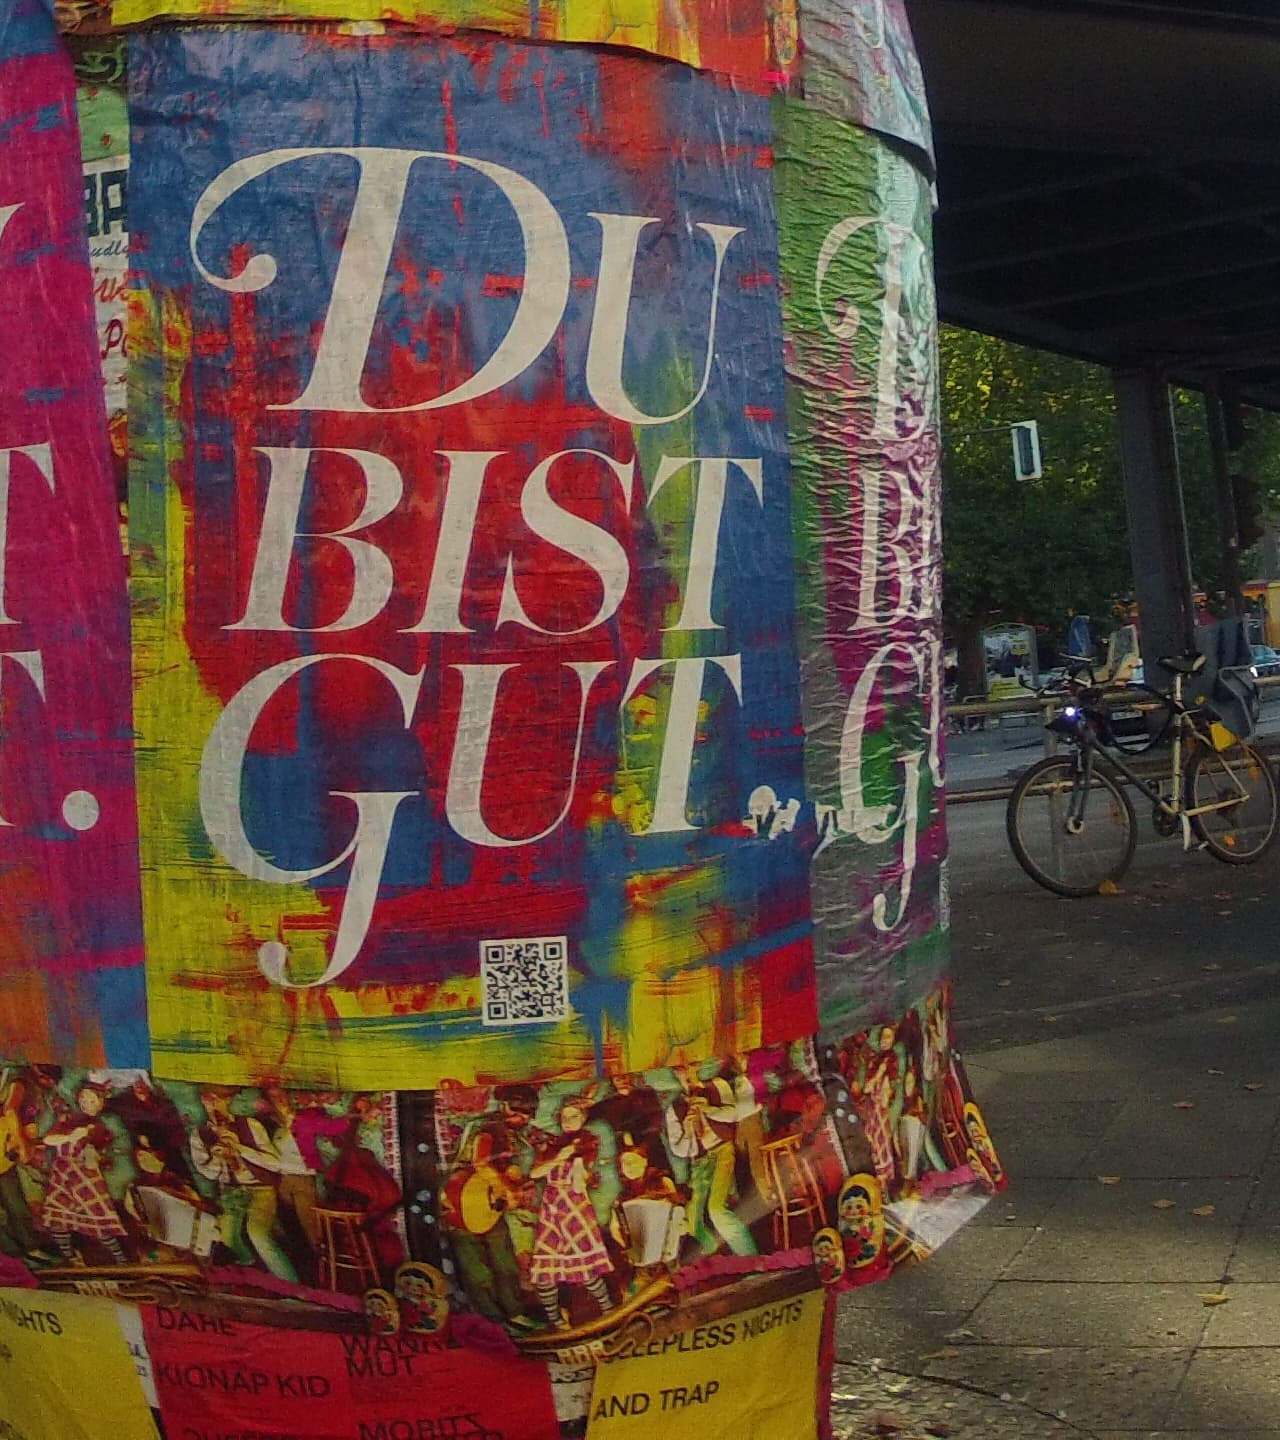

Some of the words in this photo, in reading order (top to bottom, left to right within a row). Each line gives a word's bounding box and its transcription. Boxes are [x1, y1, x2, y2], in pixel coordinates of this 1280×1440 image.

[190, 146, 746, 426] DU
[220, 445, 763, 636] BIST
[198, 652, 780, 989] GUT.
[742, 1298, 804, 1343] NIGHTS
[276, 1375, 332, 1398] KID
[593, 1392, 651, 1422] AND
[658, 1380, 720, 1411] TRAP
